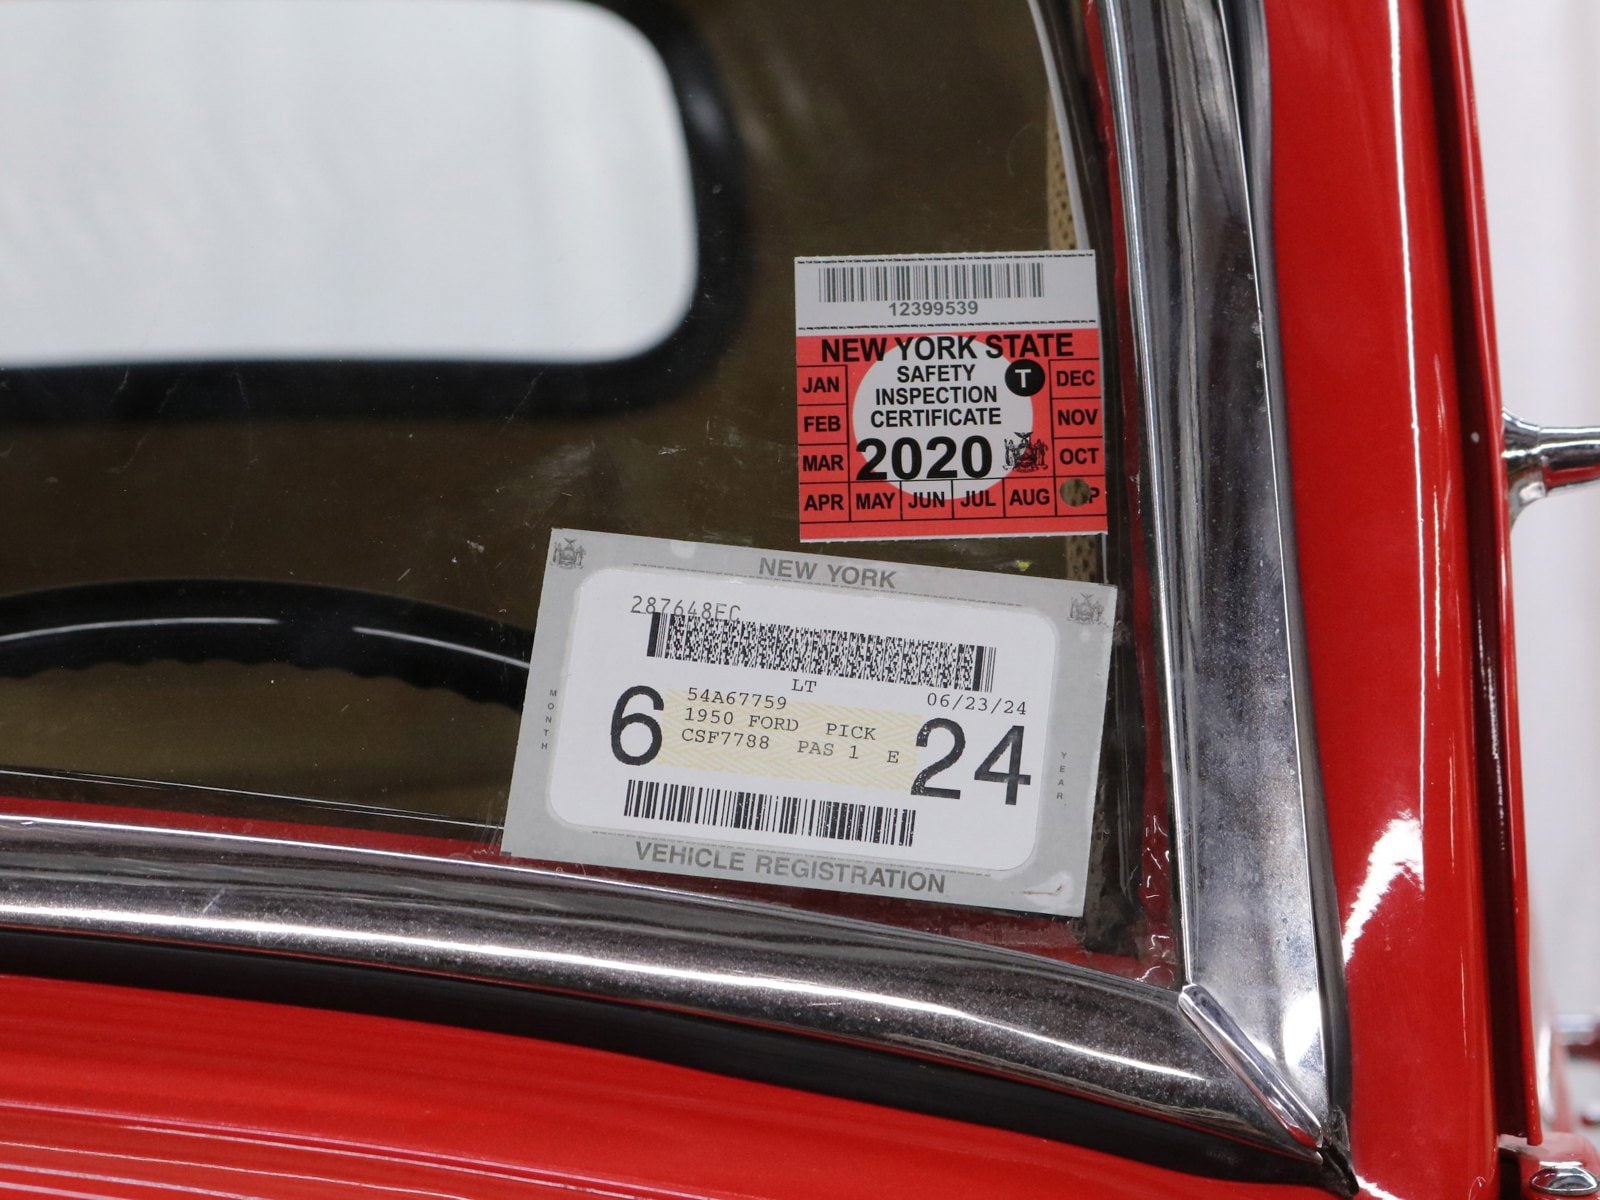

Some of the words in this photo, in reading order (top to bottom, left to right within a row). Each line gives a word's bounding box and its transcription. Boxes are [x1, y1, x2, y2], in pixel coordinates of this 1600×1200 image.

[888, 300, 979, 316] 12399539
[822, 337, 887, 362] NEW
[894, 335, 978, 360] YORK
[985, 332, 1074, 358] STATE
[897, 364, 976, 383] SAFETY
[1015, 368, 1032, 388] T
[1056, 369, 1096, 387] DEC
[802, 376, 840, 393] JAN
[875, 385, 997, 405] INSPECTION
[804, 415, 841, 432] FEB
[870, 407, 1002, 428] CERTIFICATE
[1057, 408, 1099, 426] NOV
[802, 454, 844, 471] MAR
[855, 435, 993, 481] 2020
[1059, 448, 1099, 465] OCT
[804, 493, 845, 511] APR
[856, 492, 896, 510] MAY
[908, 491, 946, 508] JUN
[960, 490, 997, 507] JUL
[1009, 488, 1050, 506] AUG
[758, 556, 817, 580] NEW
[827, 564, 897, 589] YORK
[630, 594, 742, 622] 287648EC
[791, 678, 818, 694] LT
[687, 686, 788, 711] 54A67759
[926, 692, 1028, 716] 06/23/24
[540, 689, 558, 751] MONTH
[610, 685, 665, 766] 6
[684, 707, 735, 726] 1950
[748, 715, 800, 733] FORD
[826, 722, 877, 742] PICK
[681, 728, 771, 750] CSF7788
[798, 740, 835, 758] PAS
[886, 750, 900, 765] E
[910, 717, 1031, 805] 24
[636, 840, 746, 873] VEHICLE
[754, 854, 946, 895] REGISTRATION
